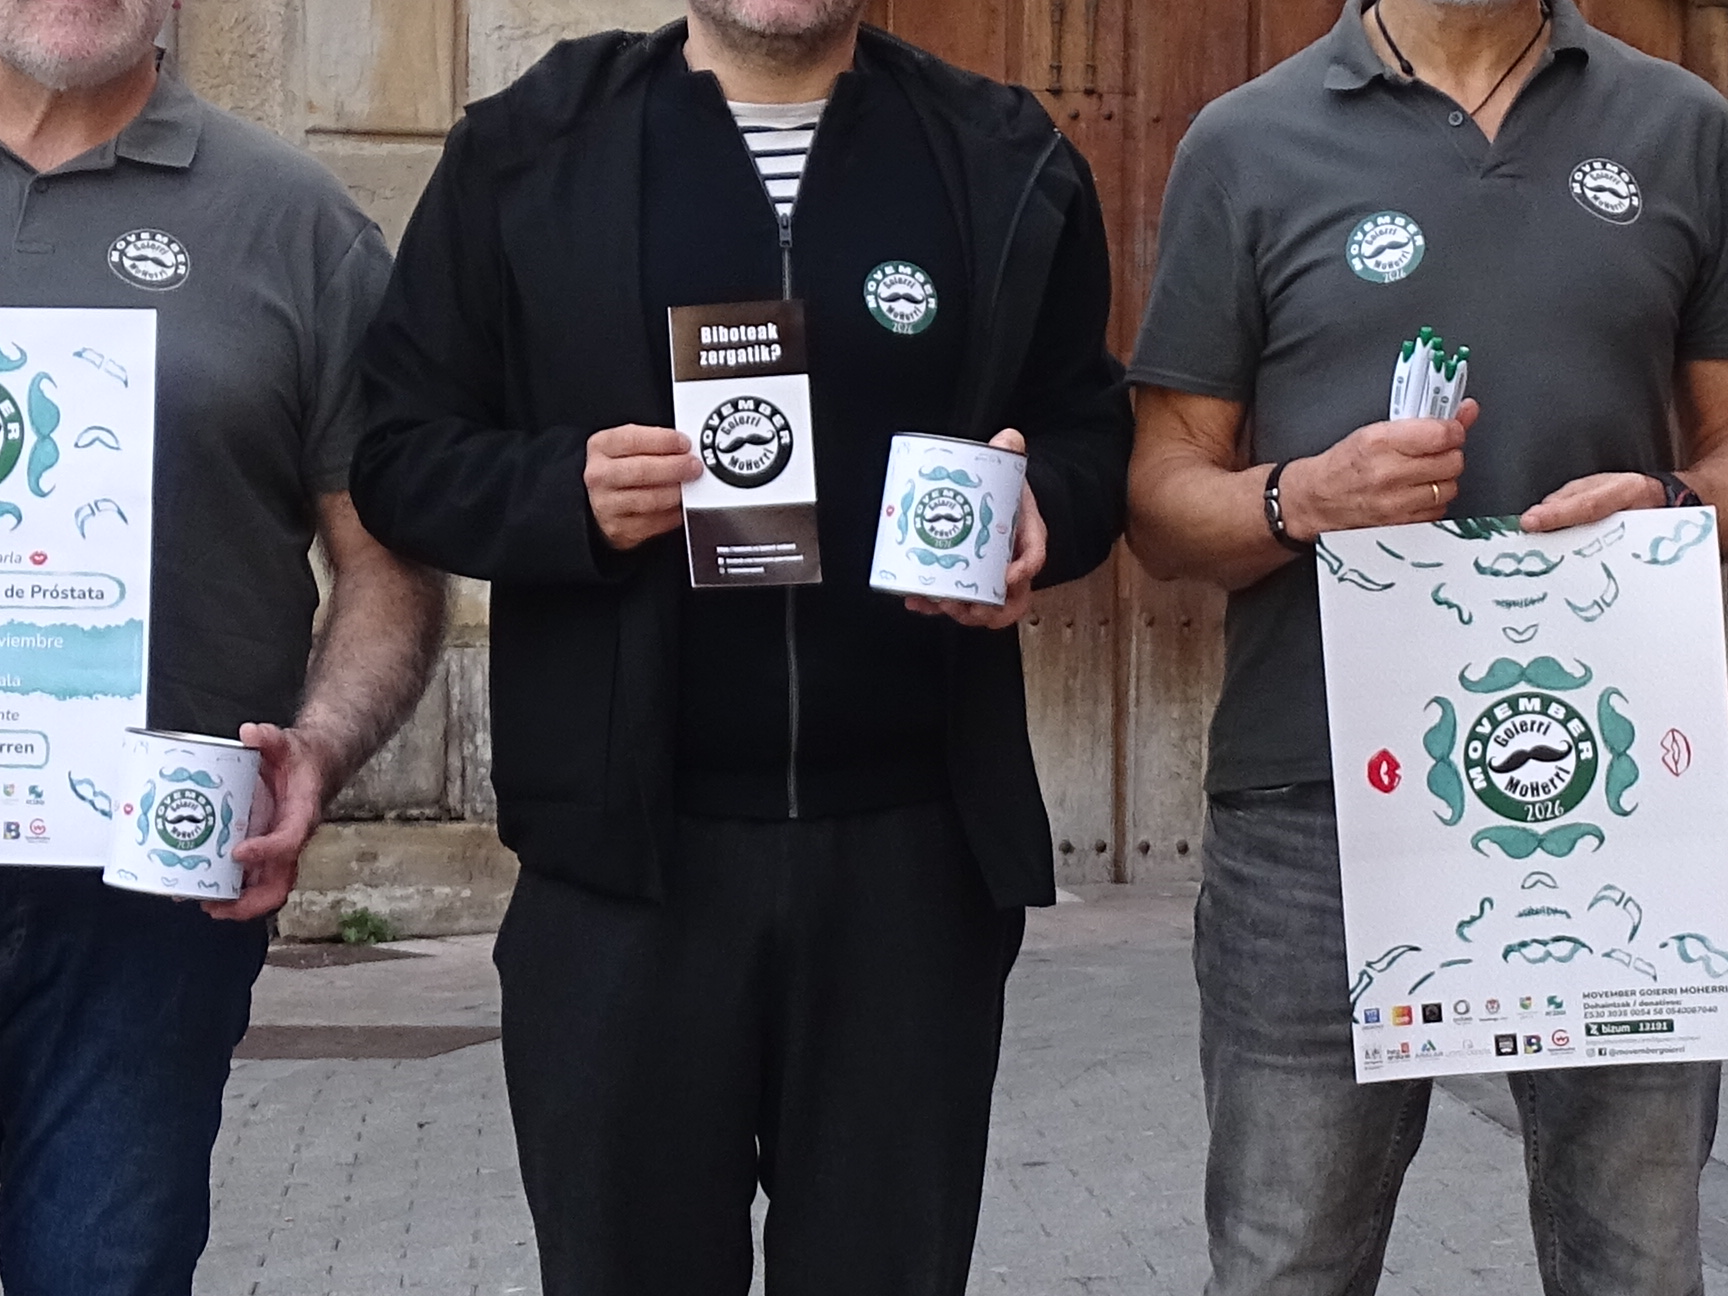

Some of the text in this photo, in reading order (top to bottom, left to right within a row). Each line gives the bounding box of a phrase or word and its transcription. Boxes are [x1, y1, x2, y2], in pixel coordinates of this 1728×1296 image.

[1572, 162, 1638, 207] MOVEMBER
[111, 232, 185, 274] MOVEMBER
[1351, 216, 1424, 270] MOVEMBER
[867, 265, 935, 308] MOVEMBER
[701, 323, 778, 343] Biboteak
[700, 344, 781, 365] zergatik?
[703, 400, 790, 466] MOVEMBER
[721, 415, 761, 435] Goierri
[728, 448, 774, 470] MoHerri
[915, 489, 971, 528] MOVEMBER
[5, 584, 24, 598] de
[31, 585, 104, 600] Próstata
[1468, 698, 1593, 790] MOVEMBER
[1494, 720, 1552, 748] Goierri
[1504, 765, 1570, 798] MoHerri
[157, 790, 213, 829] MOVEMBER
[1524, 800, 1563, 821] 2026
[1583, 986, 1728, 999] MOVEMBER GOIERRI MOHERRI
[1602, 1024, 1630, 1033] bizum
